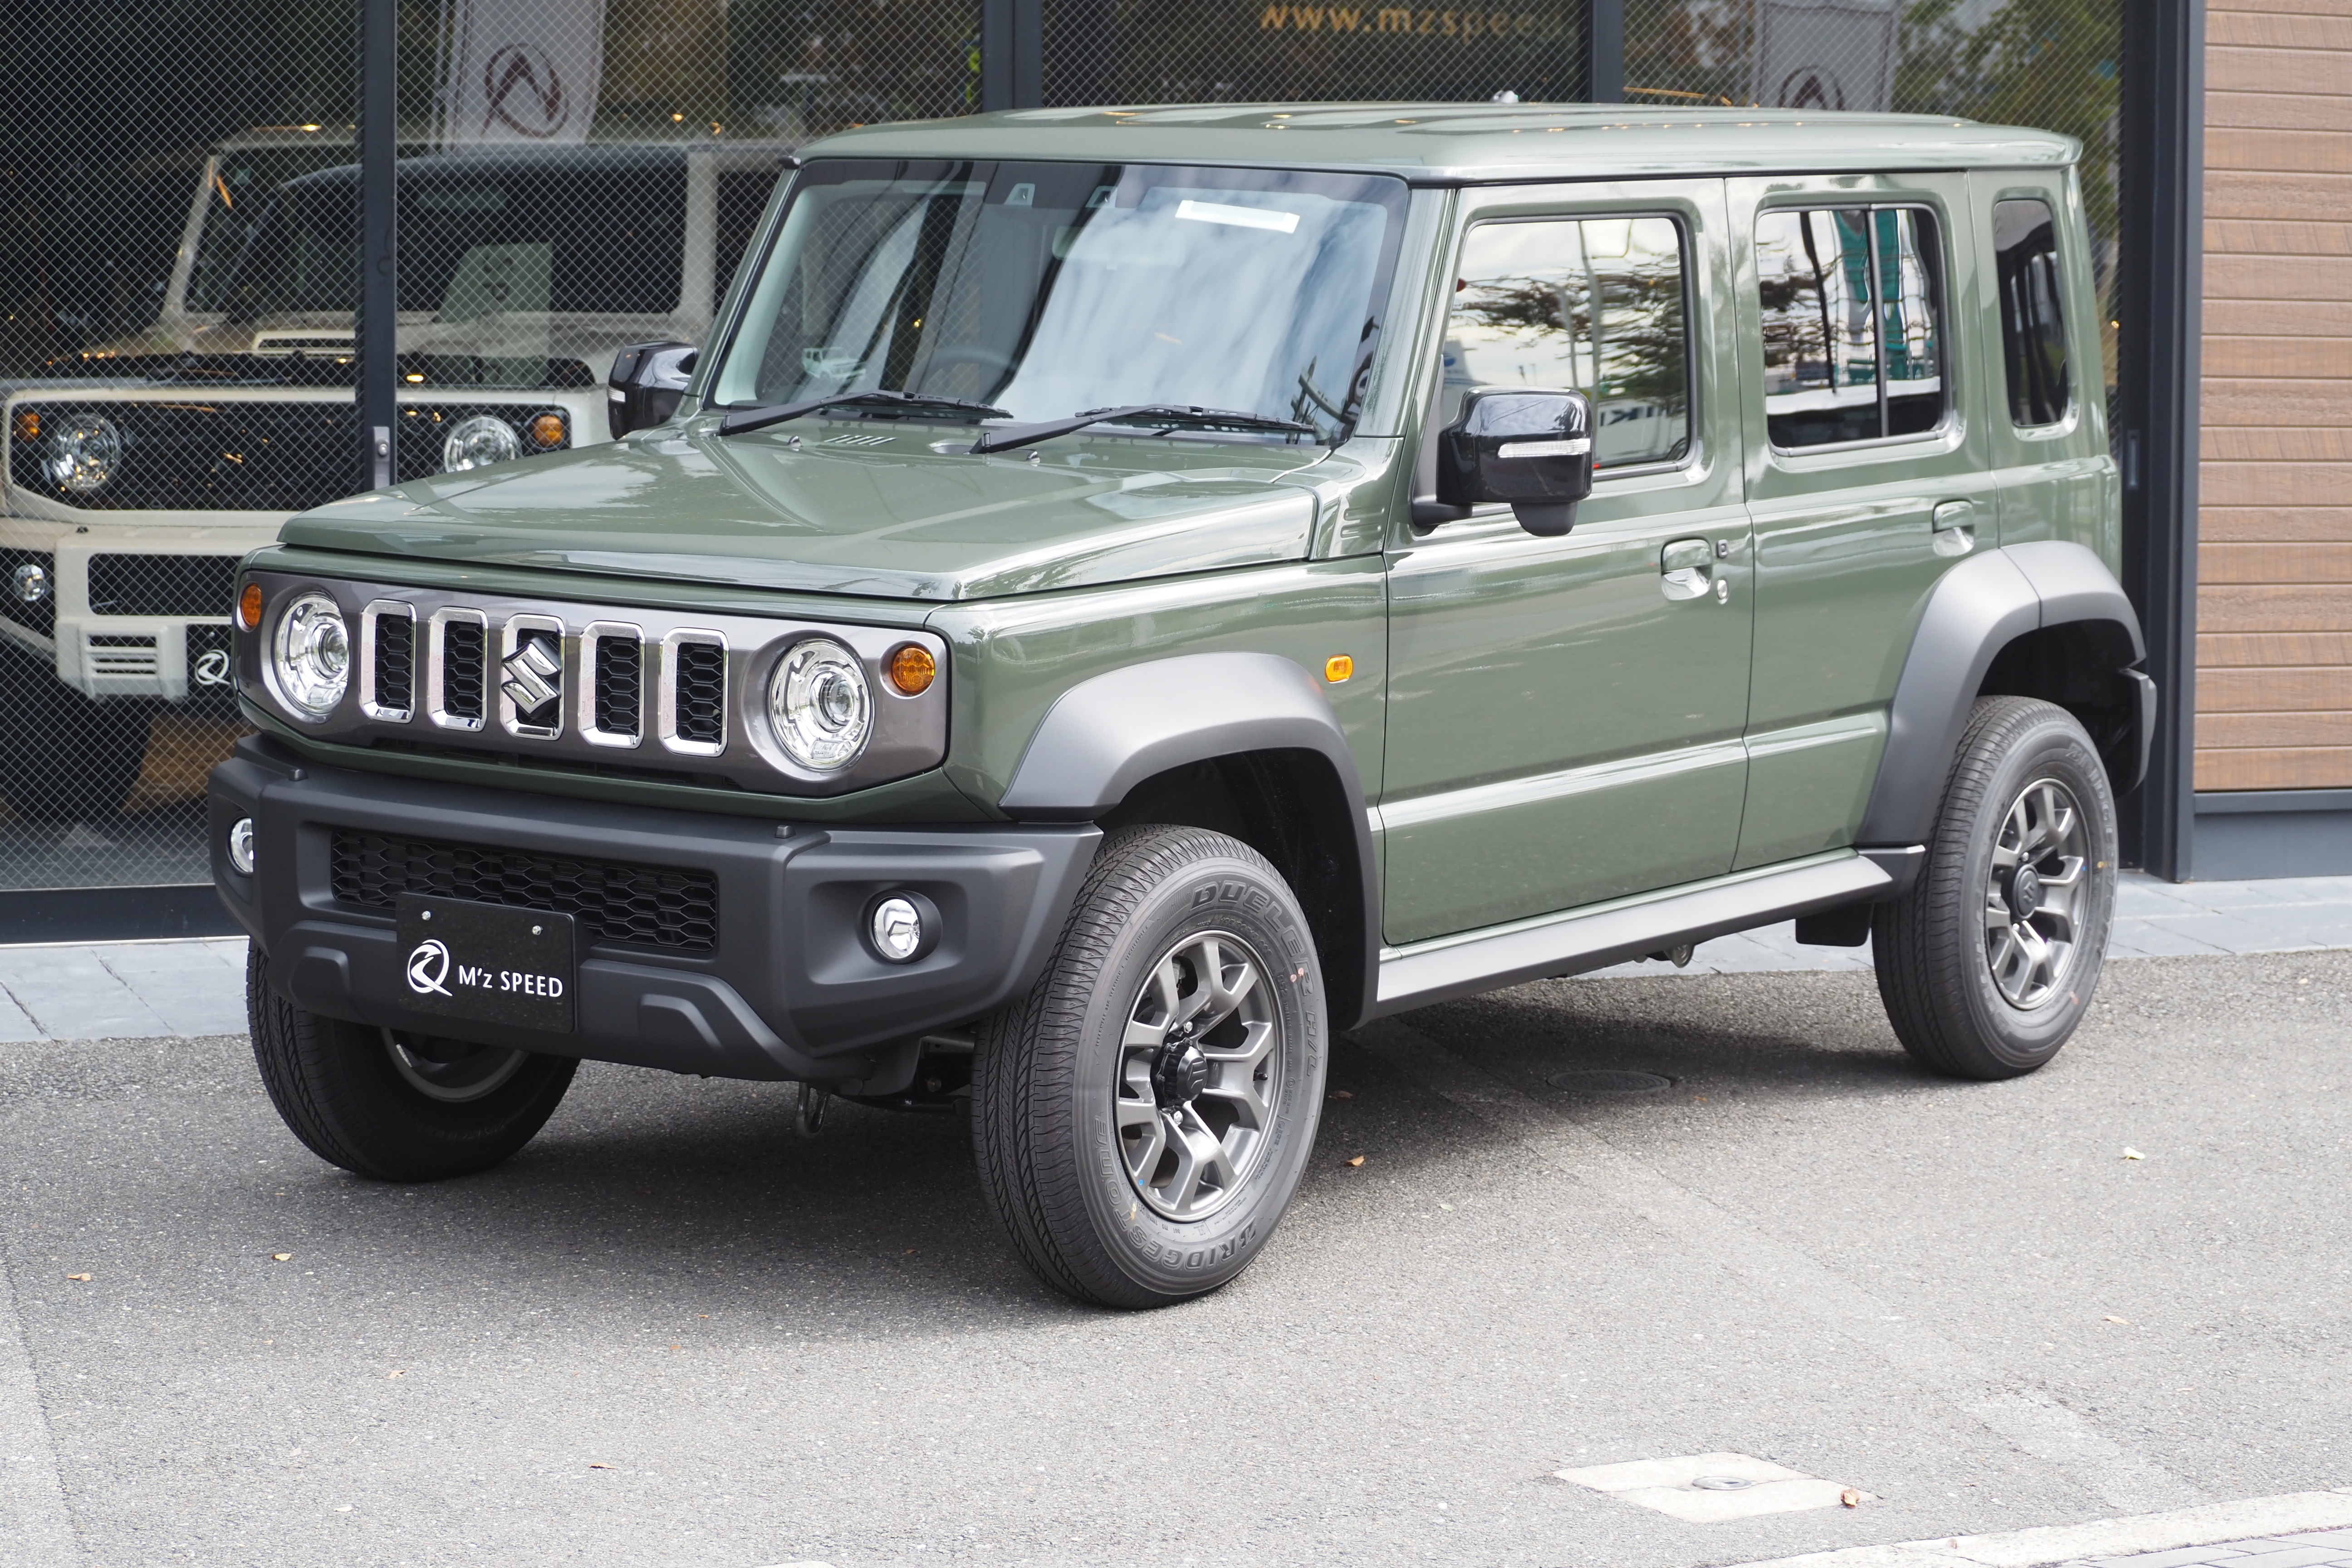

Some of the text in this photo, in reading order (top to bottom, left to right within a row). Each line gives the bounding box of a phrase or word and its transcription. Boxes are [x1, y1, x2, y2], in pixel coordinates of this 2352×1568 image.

[459, 965, 563, 997] M'z SPEED
[1189, 880, 1314, 996] DUELER
[1093, 1116, 1256, 1271] BRIDGESTONE
